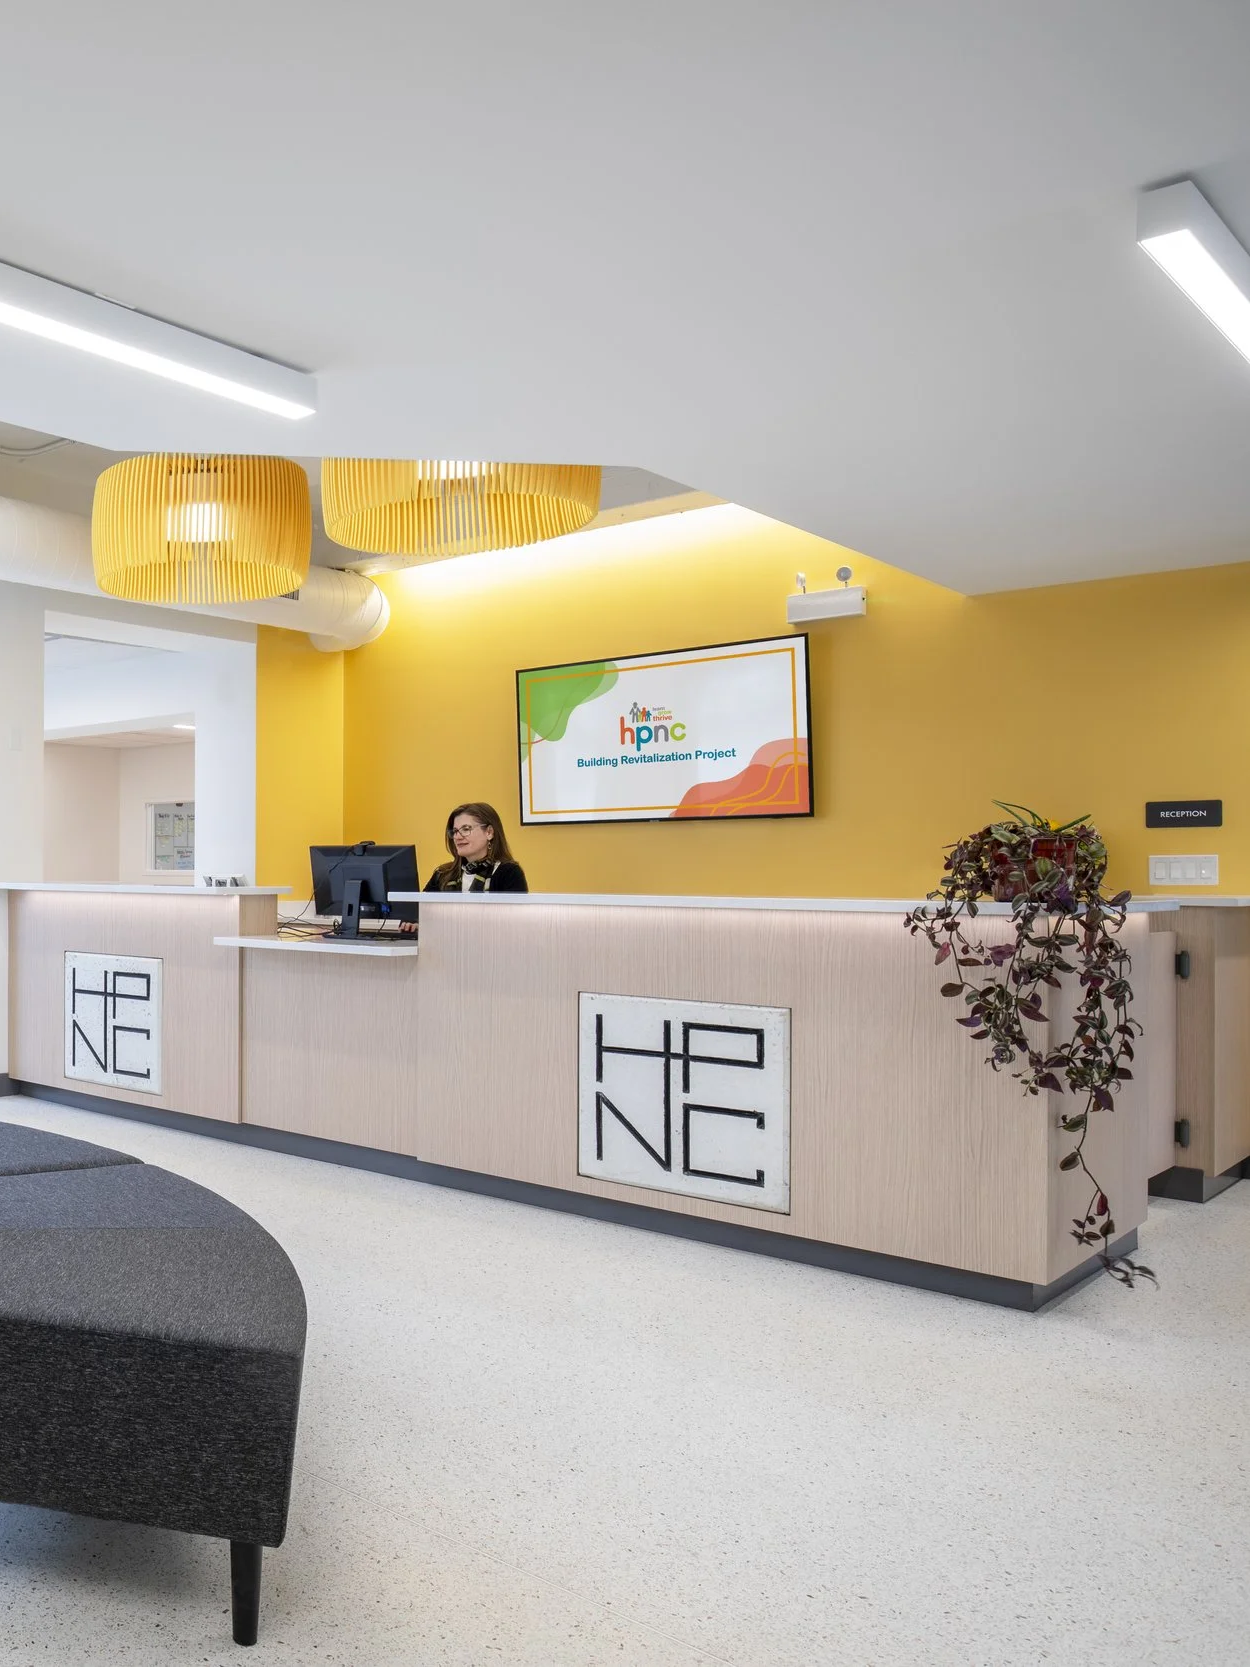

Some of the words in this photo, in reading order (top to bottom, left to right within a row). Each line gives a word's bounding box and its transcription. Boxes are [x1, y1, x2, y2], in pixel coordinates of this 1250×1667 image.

[620, 716, 686, 751] hpnc
[577, 756, 618, 768] Building
[621, 752, 692, 765] Revitalization
[695, 748, 736, 762] Project
[1160, 810, 1207, 818] RECEPTION
